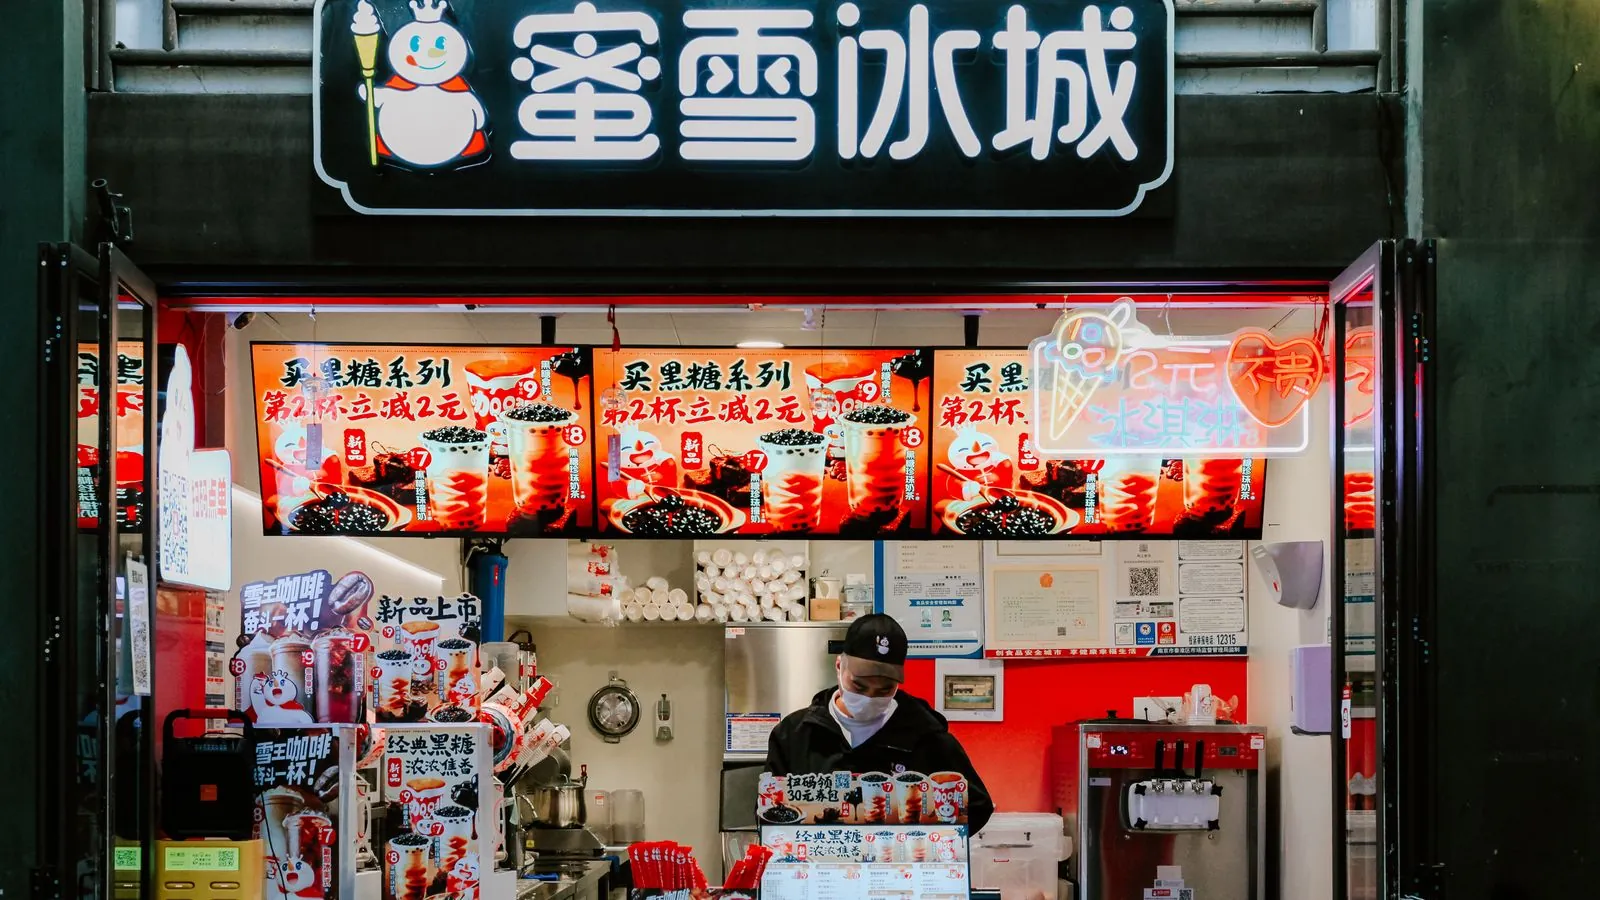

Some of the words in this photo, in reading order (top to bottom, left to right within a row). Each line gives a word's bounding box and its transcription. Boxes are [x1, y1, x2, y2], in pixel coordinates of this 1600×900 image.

[510, 2, 1139, 161] 蜜雪冰城
[280, 357, 451, 389] 买黑糖系列
[620, 359, 791, 391] 买黑糖系列
[960, 362, 1028, 393] 买黑
[1231, 352, 1315, 399] 不贵
[262, 392, 467, 422] 第2杯立减2元
[601, 396, 806, 426] 第2杯立减2元
[940, 396, 1028, 427] 第2杯
[347, 434, 363, 461] 新品
[684, 437, 700, 464] 新品
[244, 571, 326, 610] 雪王咖啡
[375, 594, 478, 624] 新品上市
[1217, 634, 1237, 645] 12315
[256, 733, 333, 765] 雪王咖啡
[386, 734, 476, 757] 经典黑糖
[389, 763, 401, 782] 新品
[405, 758, 474, 776] 浓浓焦香
[787, 775, 833, 789] 扫码领
[787, 788, 839, 802] 30元券包
[795, 829, 864, 844] 经典黑糖
[809, 845, 862, 858] 浓浓焦香
